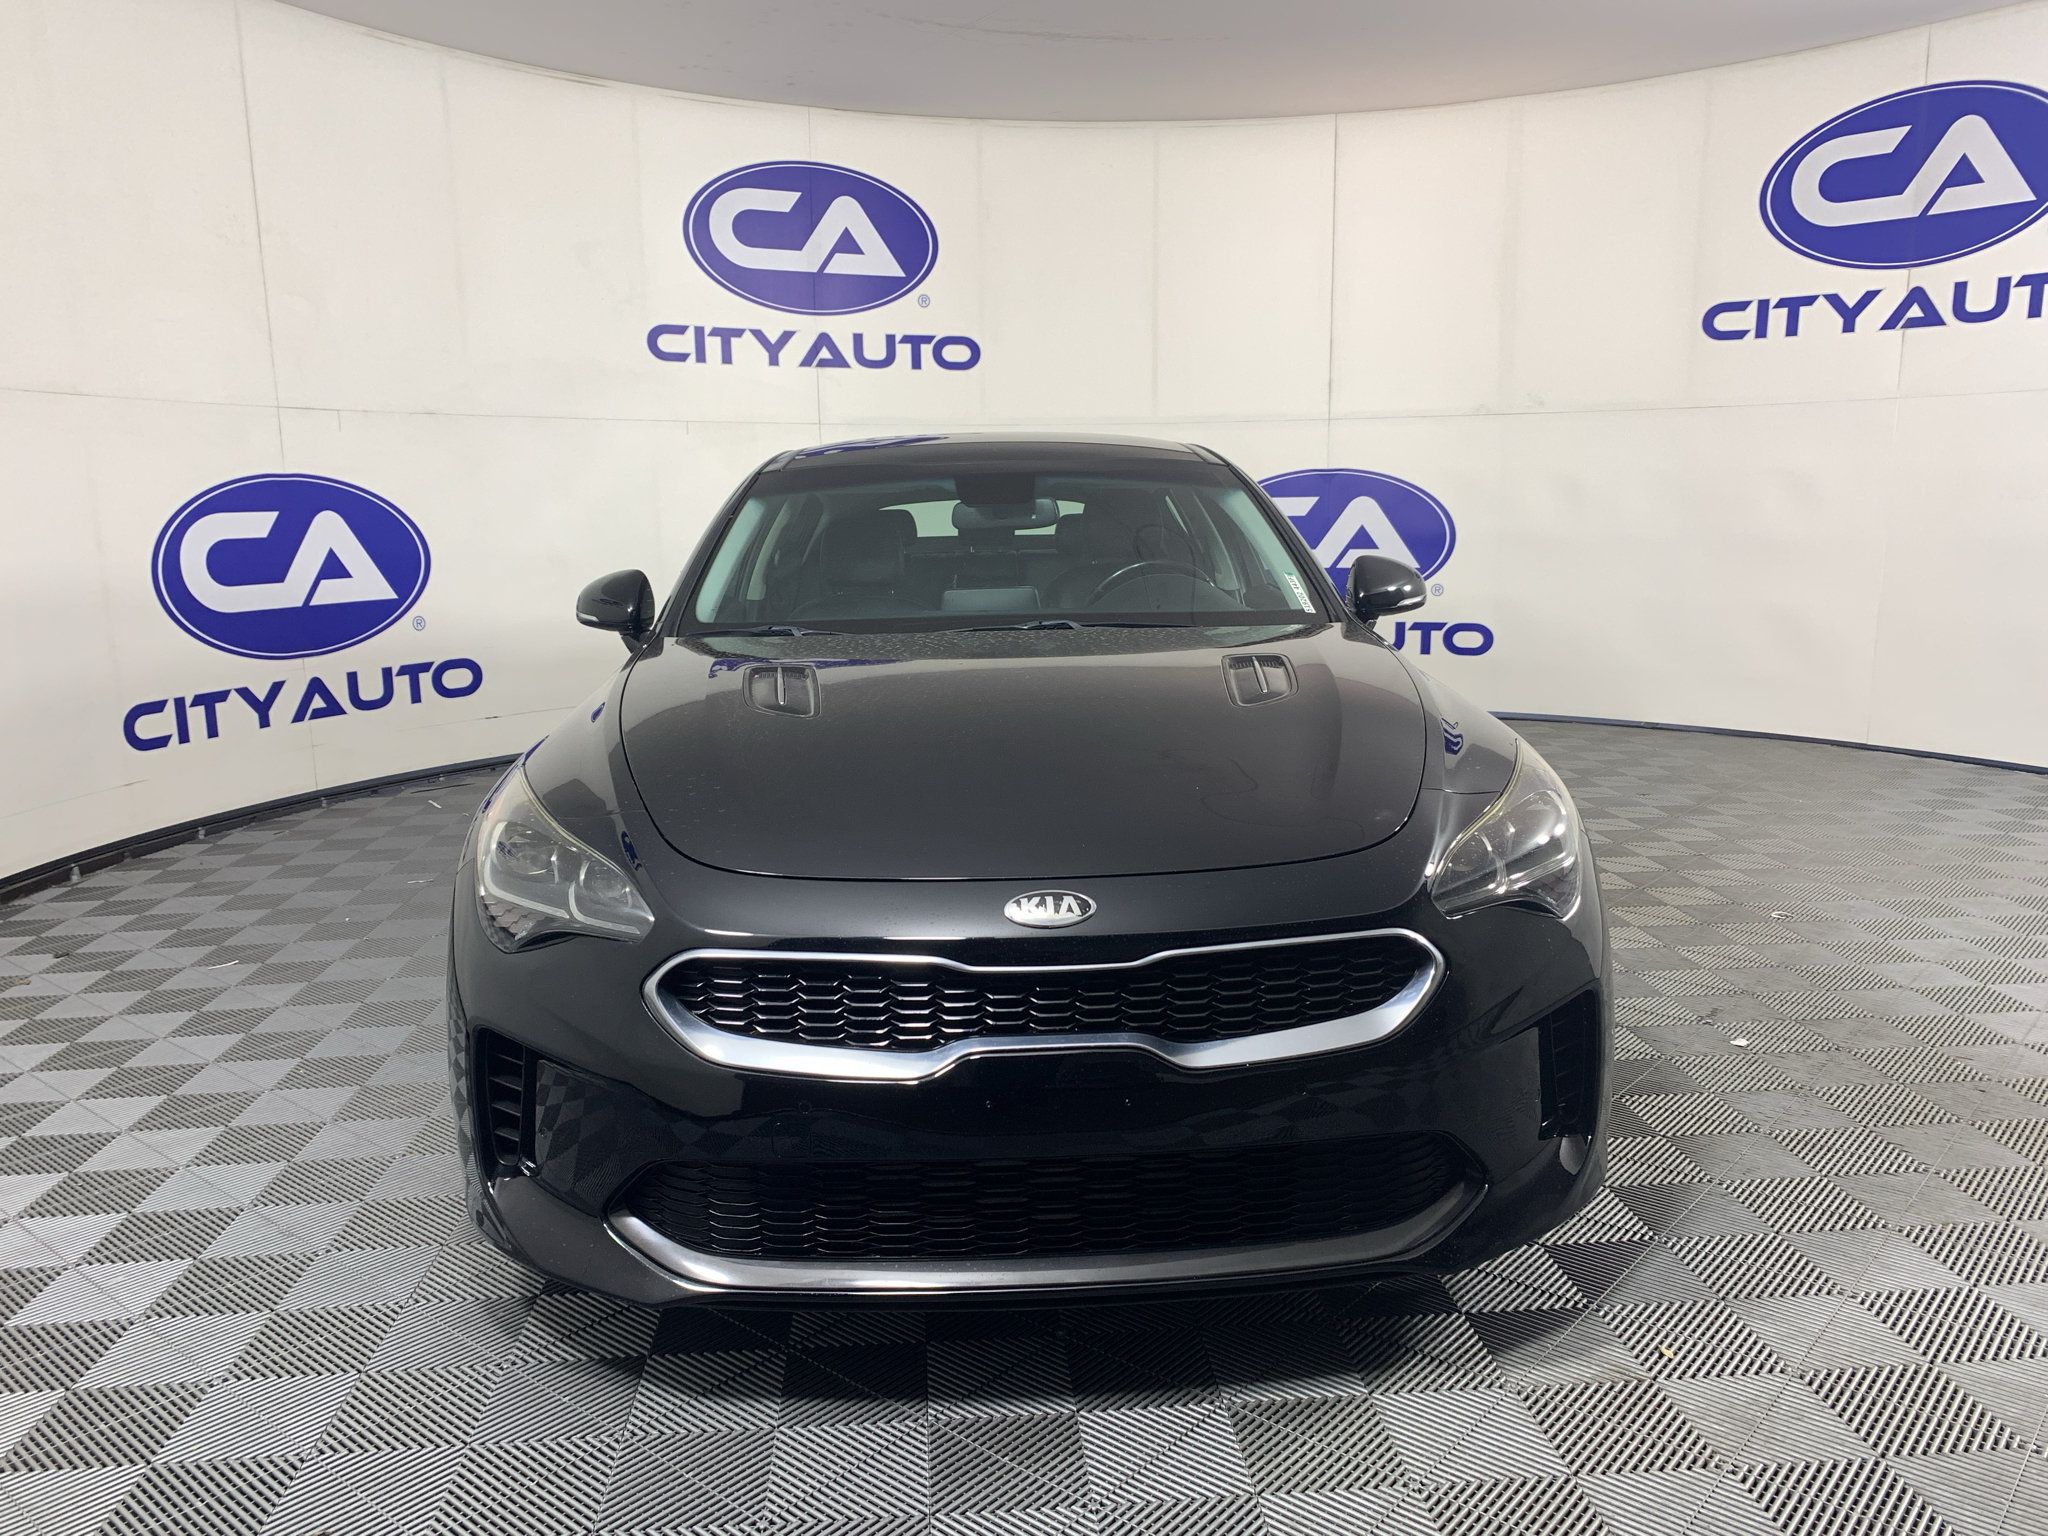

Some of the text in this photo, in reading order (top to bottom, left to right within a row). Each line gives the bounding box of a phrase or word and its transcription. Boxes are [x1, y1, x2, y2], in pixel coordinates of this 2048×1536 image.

[1790, 113, 2038, 228] CA
[708, 187, 907, 278] CA
[1878, 272, 2048, 332] AUT
[179, 509, 400, 614] CA
[1392, 621, 1494, 656] TO
[1018, 895, 1083, 918] KIA
